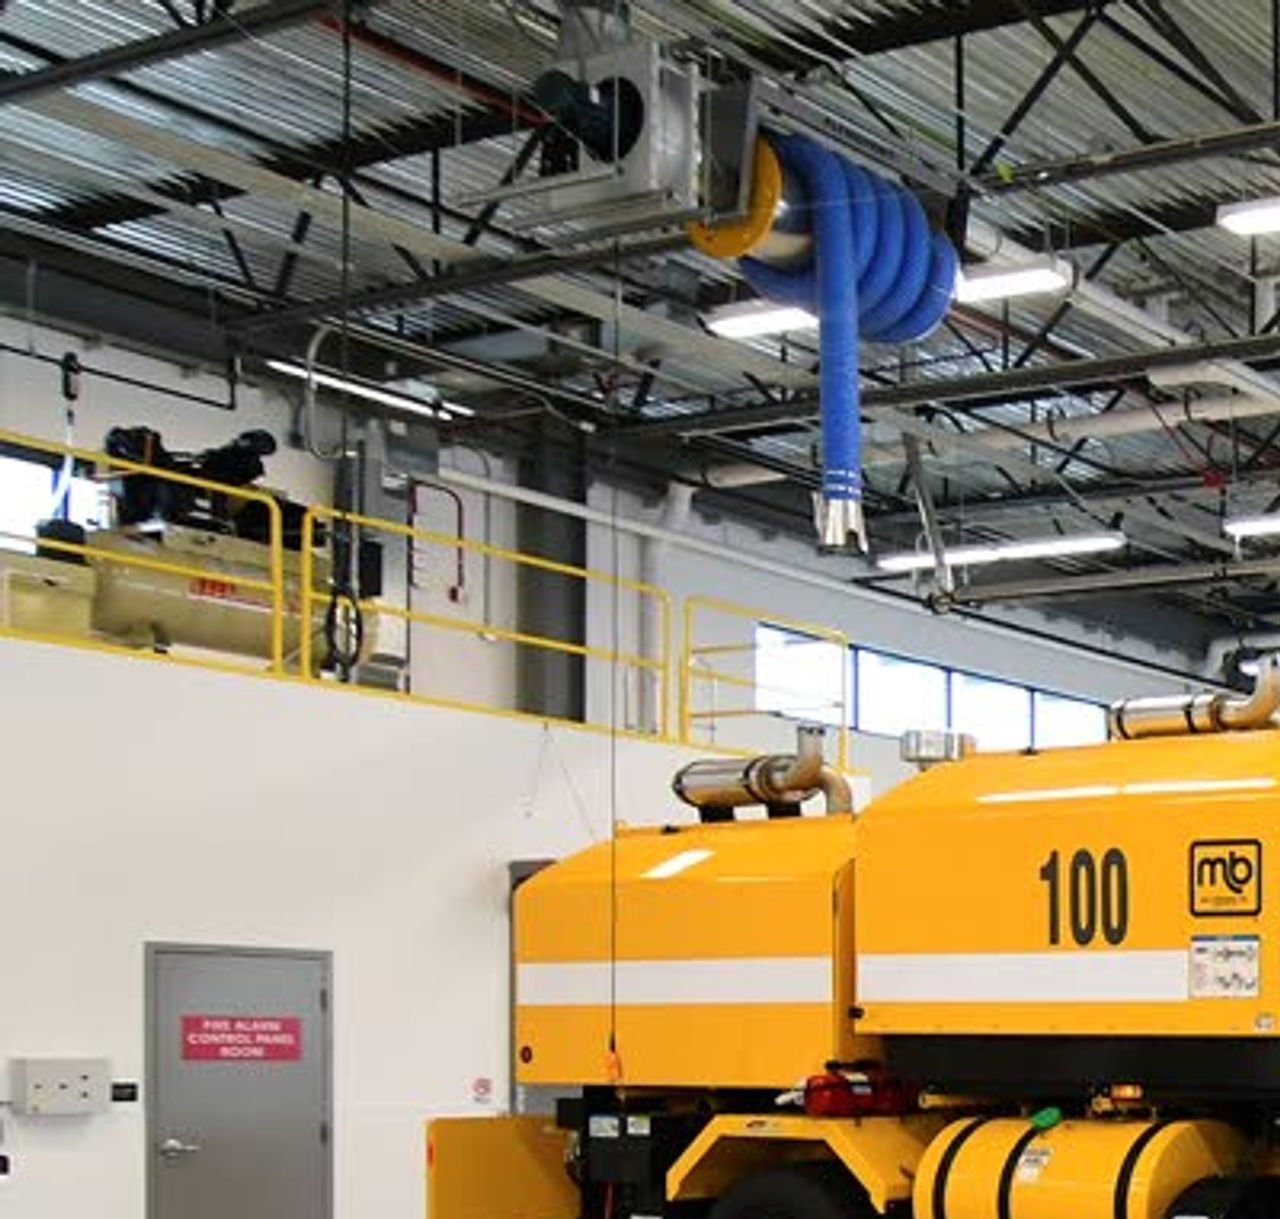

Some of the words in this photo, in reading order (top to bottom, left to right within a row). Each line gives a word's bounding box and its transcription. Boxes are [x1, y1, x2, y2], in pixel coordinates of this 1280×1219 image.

[1197, 851, 1252, 893] mb
[1039, 847, 1128, 945] 100
[203, 1020, 230, 1031] FIRE
[233, 1020, 281, 1032] ALARM
[188, 1033, 252, 1045] CONTROL
[255, 1033, 295, 1045] PANEL
[219, 1046, 264, 1058] ROOM
